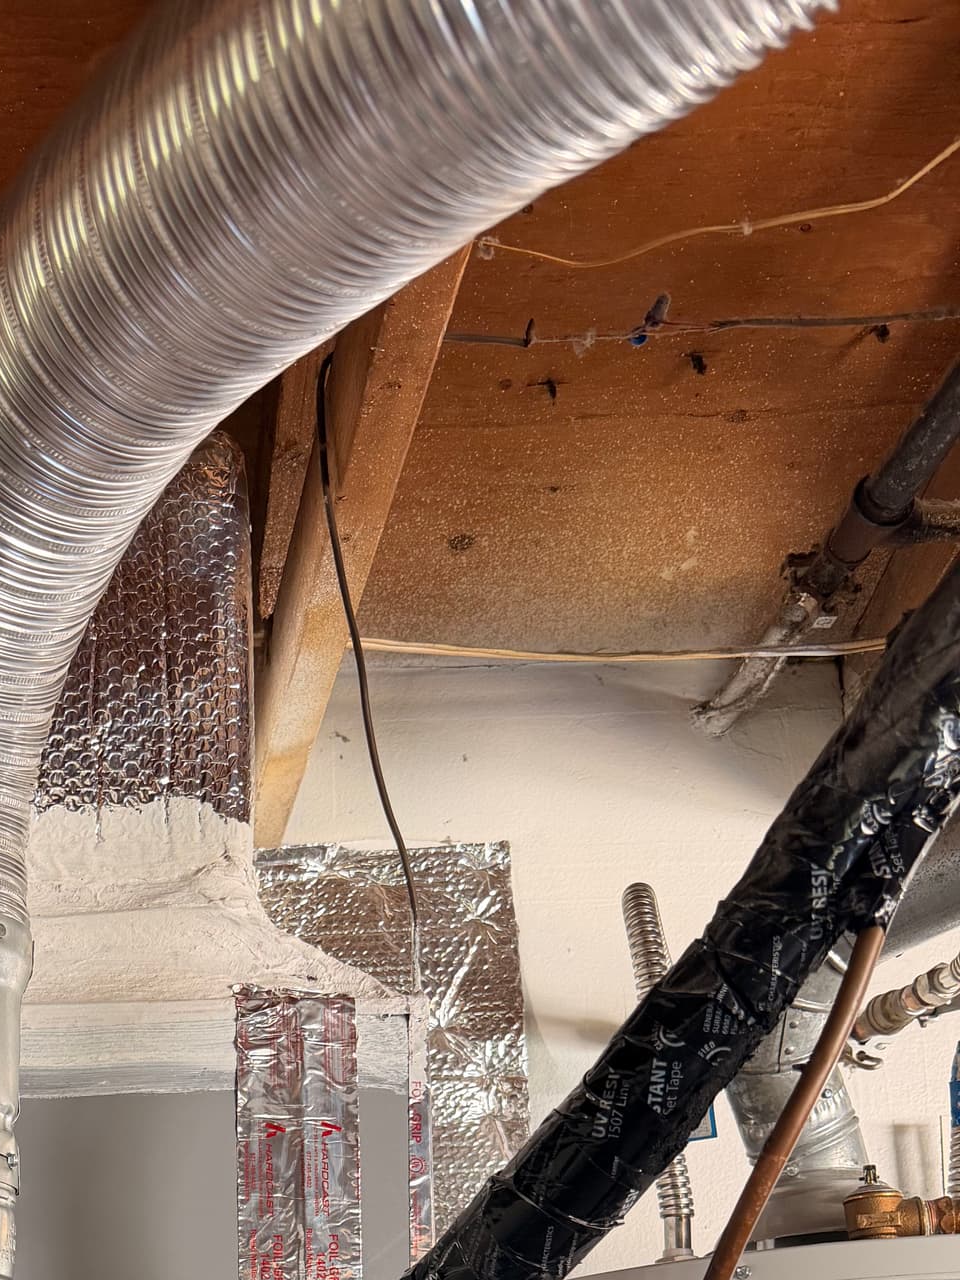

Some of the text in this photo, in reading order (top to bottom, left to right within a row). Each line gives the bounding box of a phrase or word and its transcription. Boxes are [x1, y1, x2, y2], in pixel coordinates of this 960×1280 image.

[667, 1061, 684, 1092] Tape
[592, 1112, 608, 1138] UV
[608, 1110, 623, 1138] 1507
[321, 1142, 330, 1216] HARDCAST
